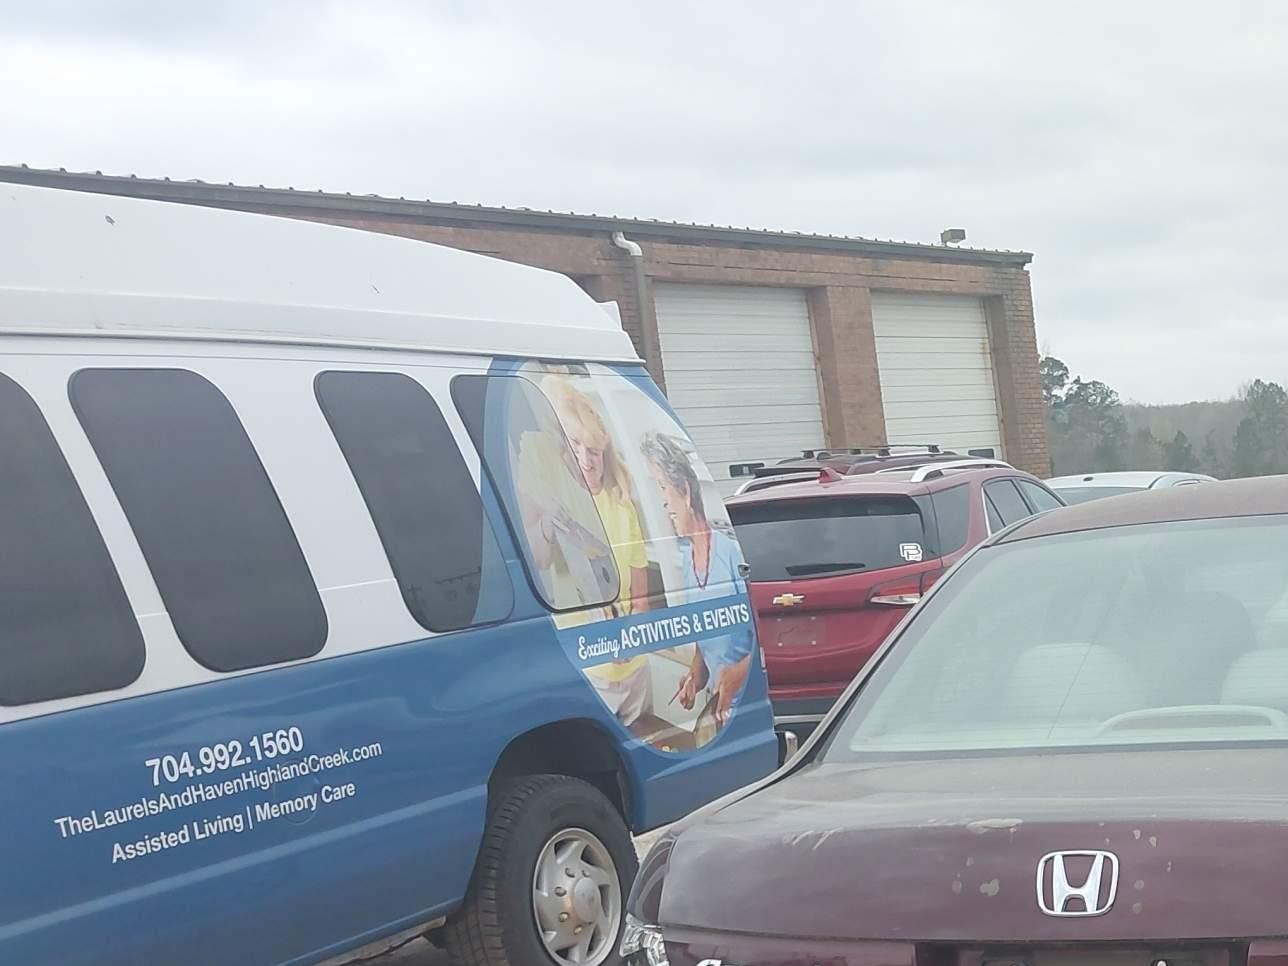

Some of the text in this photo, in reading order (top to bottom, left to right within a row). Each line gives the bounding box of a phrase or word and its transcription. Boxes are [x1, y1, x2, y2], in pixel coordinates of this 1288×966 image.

[578, 603, 750, 660] Exciting ACTIVITIES & EVENTS
[54, 741, 383, 839] TheLaurelsAndHavenHighlandCreek.com
[145, 726, 304, 787] 704.992.1560
[112, 825, 190, 864] Assisted
[194, 811, 244, 841] Living
[256, 791, 318, 823] Memory
[321, 781, 356, 804] Care
